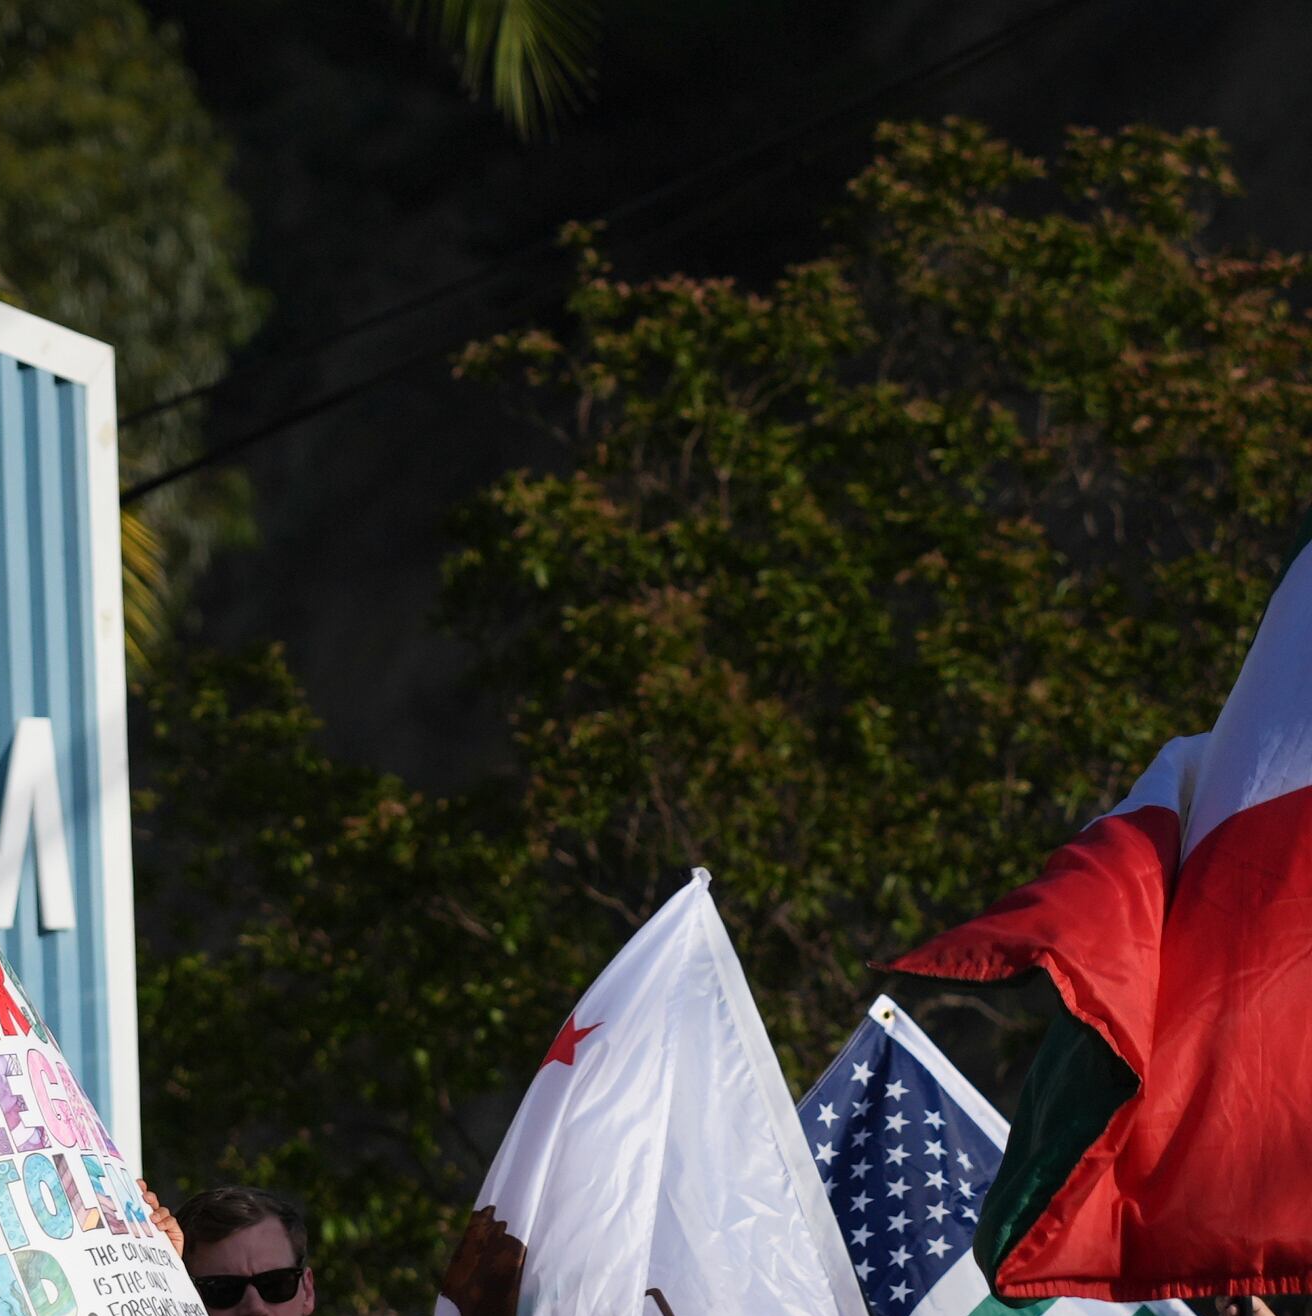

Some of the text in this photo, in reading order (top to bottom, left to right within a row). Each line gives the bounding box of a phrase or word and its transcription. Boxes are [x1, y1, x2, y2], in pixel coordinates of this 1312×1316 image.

[85, 1244, 118, 1266] THE
[93, 1270, 172, 1296] IS THE ONLY
